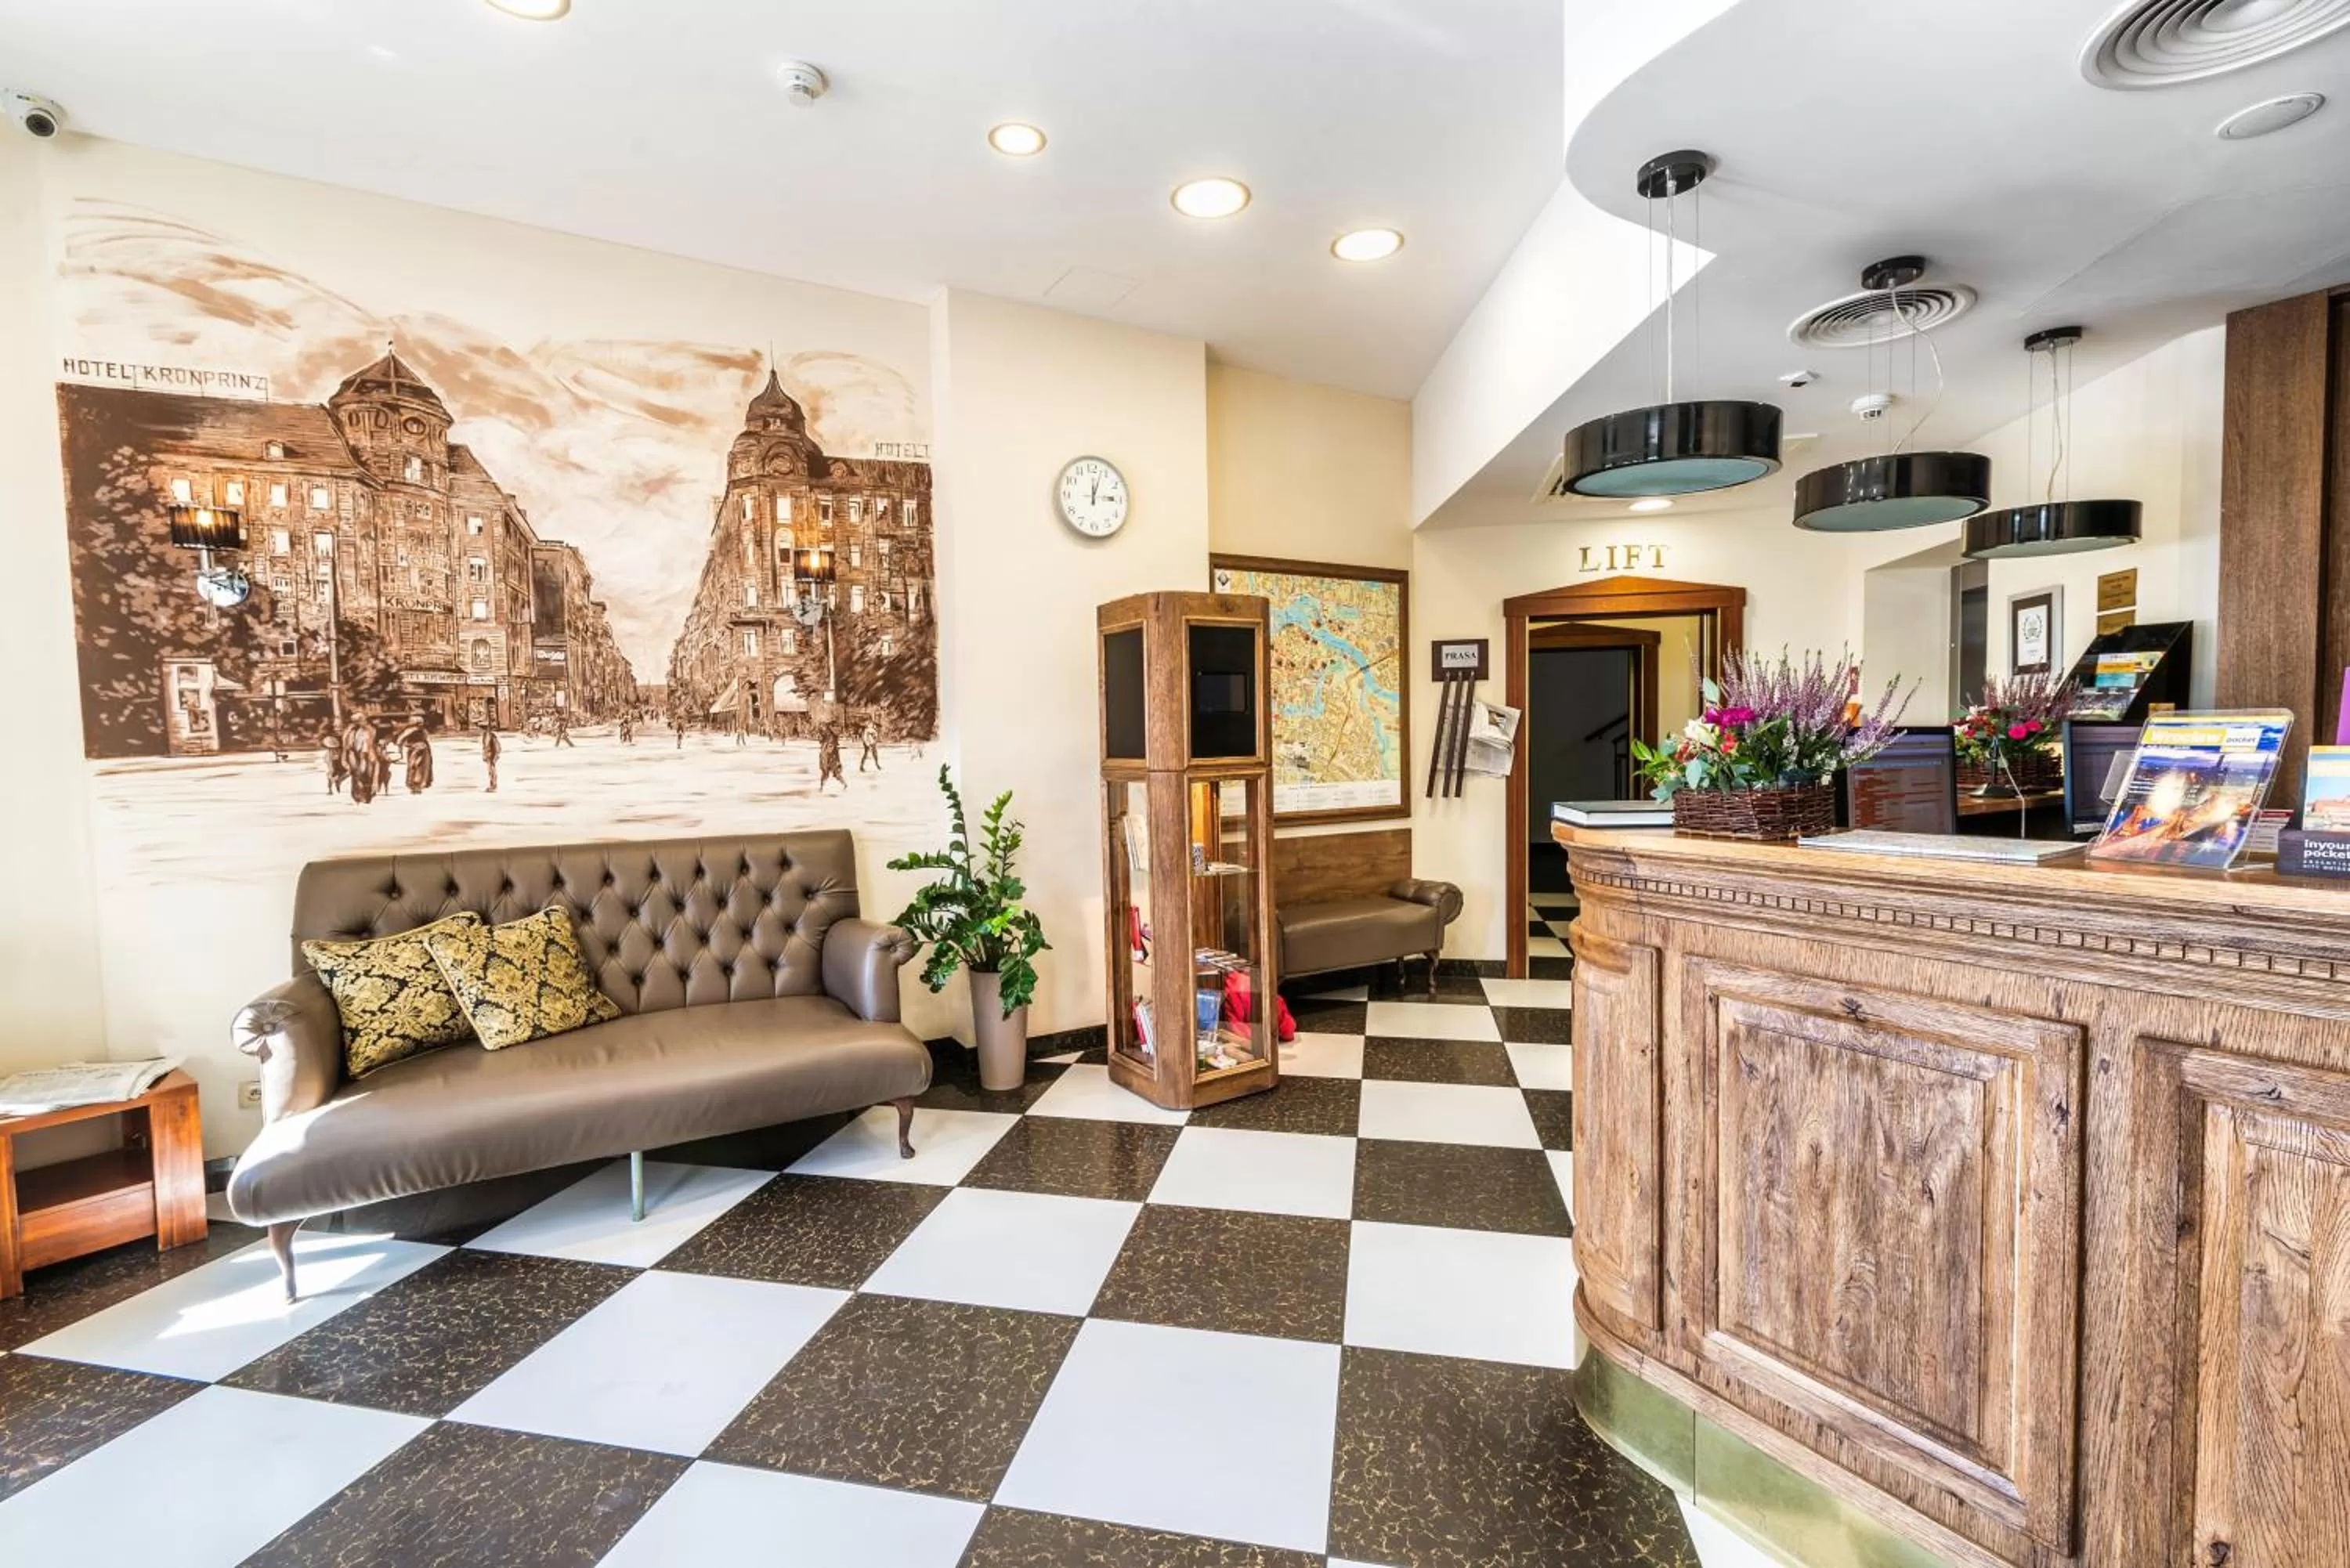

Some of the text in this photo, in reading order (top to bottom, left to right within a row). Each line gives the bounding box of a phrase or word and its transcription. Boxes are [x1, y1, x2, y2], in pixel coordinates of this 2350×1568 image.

[63, 357, 132, 380] HOTEL
[1086, 463, 1097, 473] 12
[1578, 544, 1670, 573] LIFT
[1444, 651, 1477, 660] PRASA
